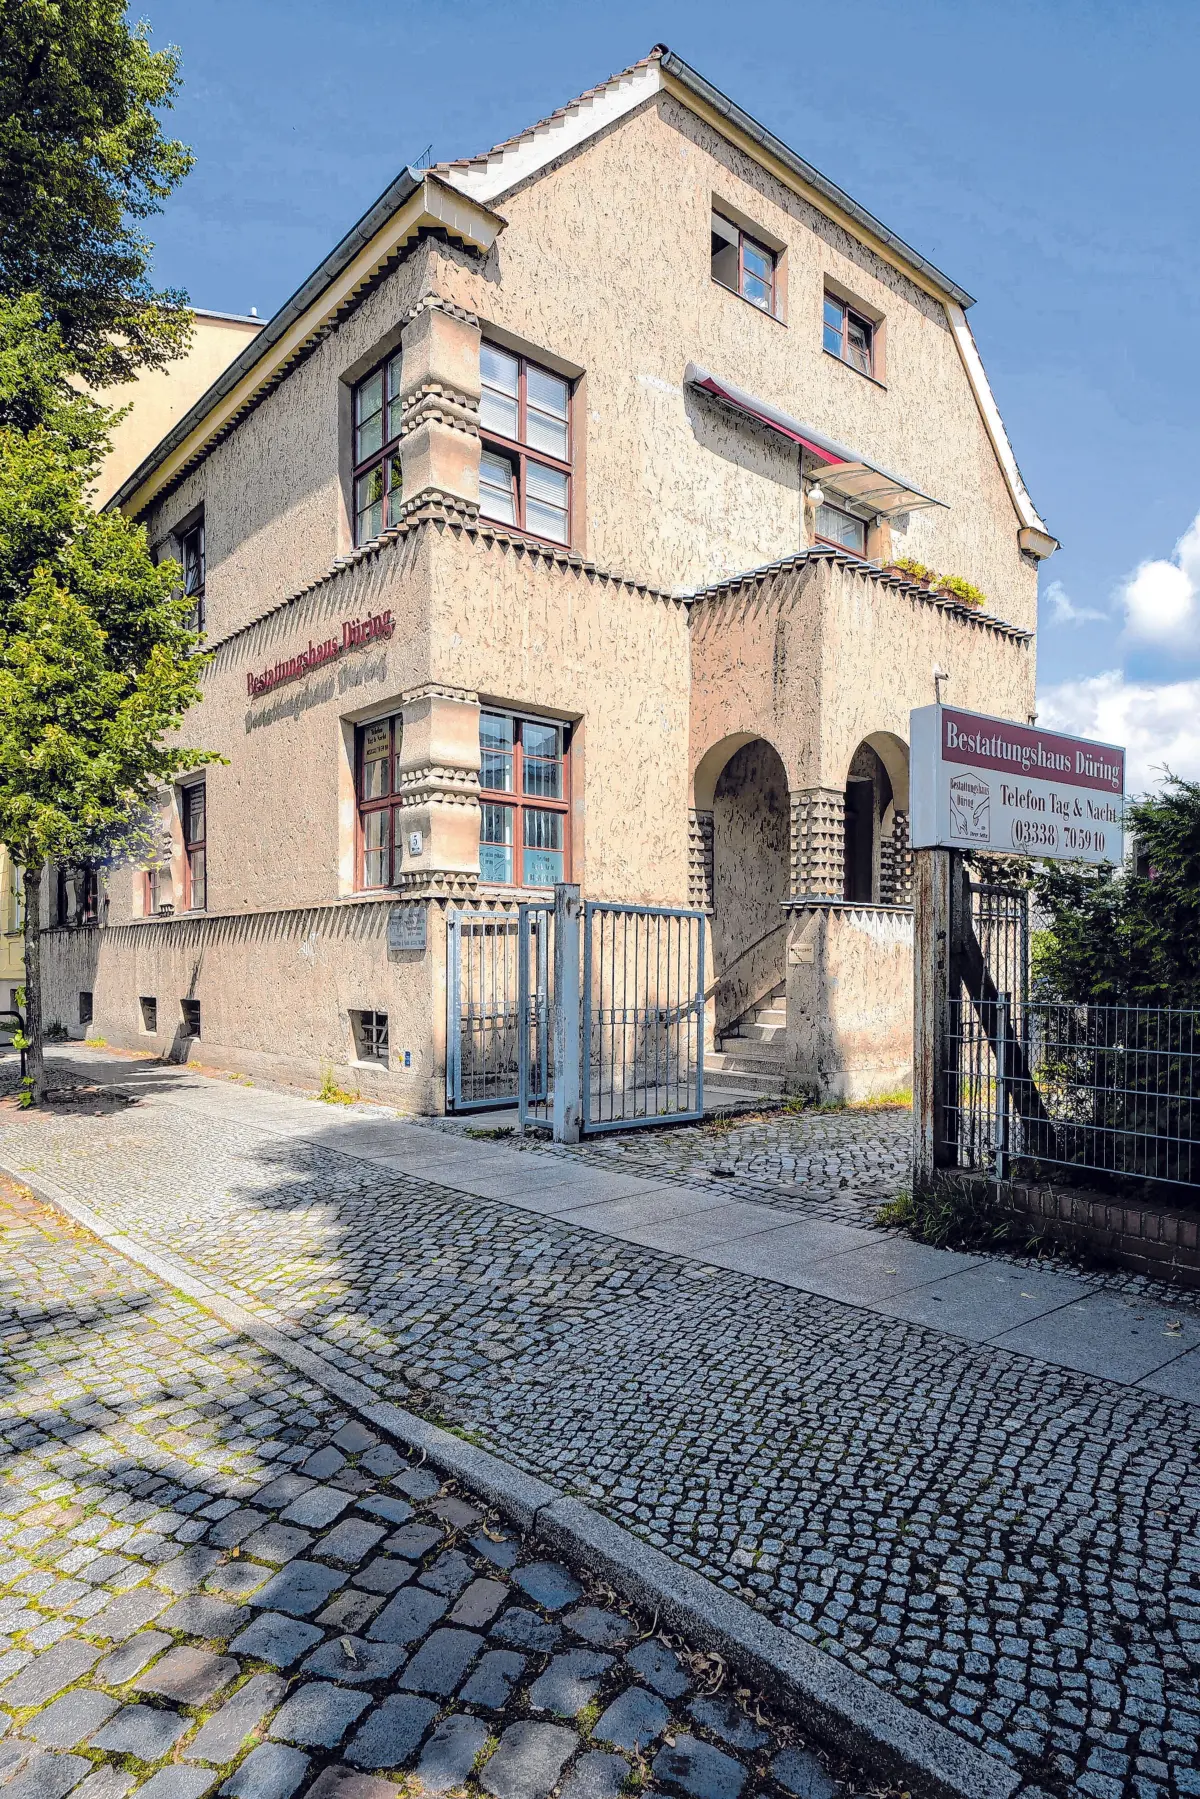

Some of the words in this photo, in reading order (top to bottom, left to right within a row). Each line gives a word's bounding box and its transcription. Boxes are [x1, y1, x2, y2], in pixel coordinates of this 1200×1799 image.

[246, 636, 338, 696] Bestattungshaus
[342, 609, 396, 651] Düring
[946, 721, 1072, 772] Bestattungshaus
[1075, 751, 1120, 788] Düring
[950, 778, 989, 796] Bestattungshaus
[957, 794, 974, 810] Düring
[1000, 784, 1046, 812] Telefon
[1049, 793, 1070, 821] Tag
[1073, 798, 1083, 817] &
[1086, 800, 1117, 823] Nacht
[1011, 818, 1059, 852] (03338)
